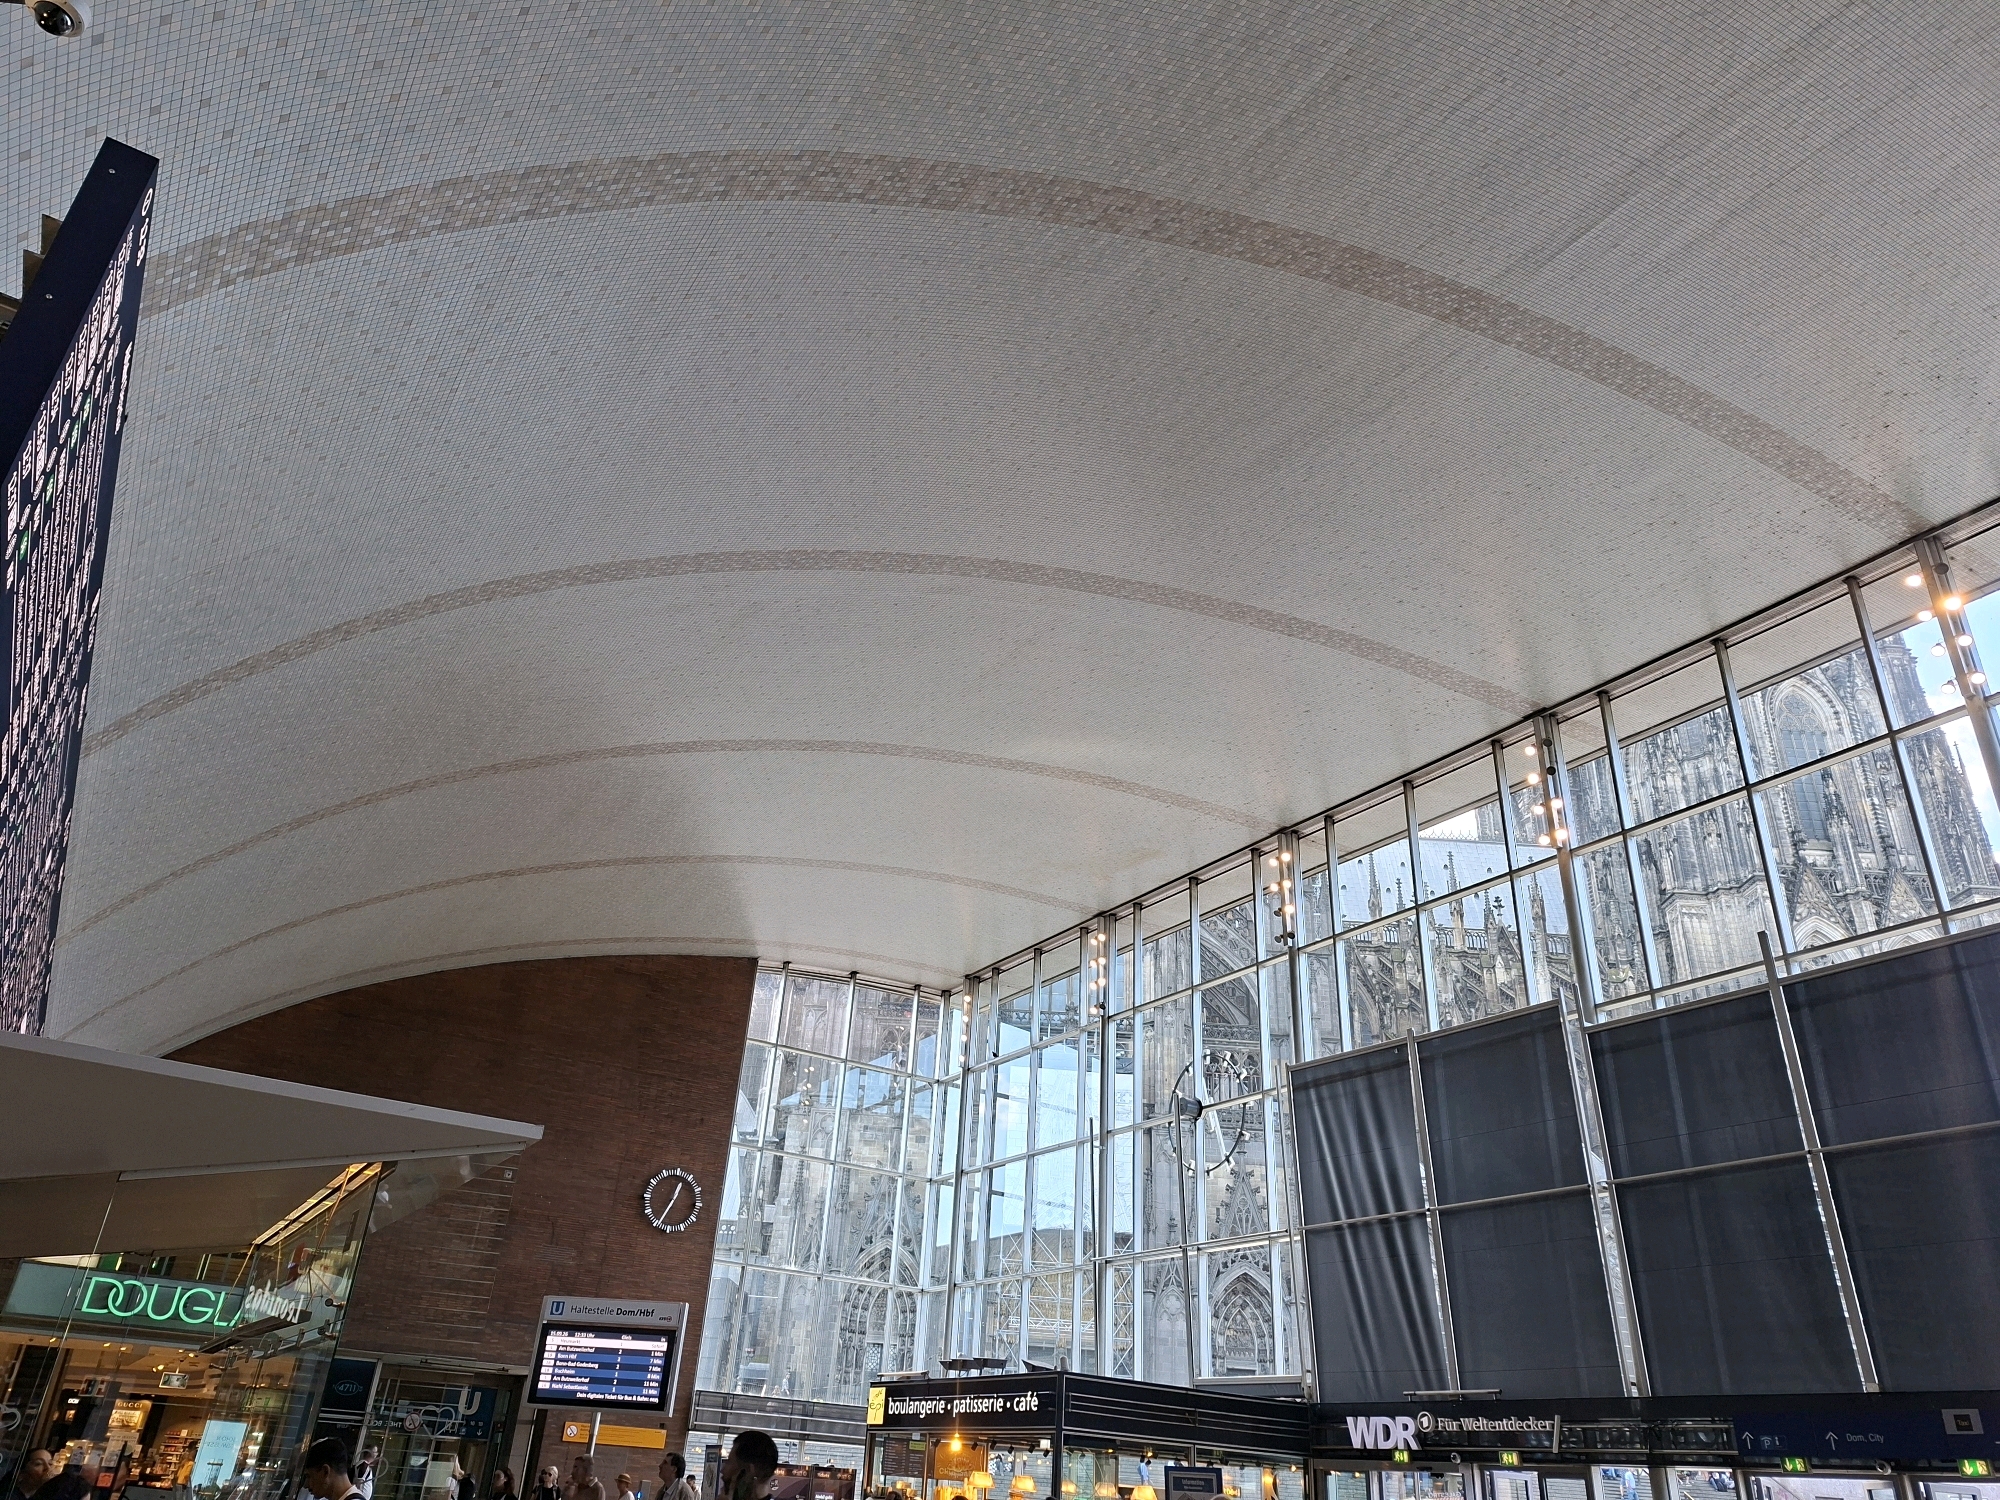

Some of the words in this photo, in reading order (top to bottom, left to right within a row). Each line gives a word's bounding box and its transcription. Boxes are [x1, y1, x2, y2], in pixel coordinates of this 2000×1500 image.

[81, 1276, 243, 1327] DOUGL
[570, 1305, 615, 1316] Haltestelle
[616, 1308, 655, 1317] Dom/Hbf
[117, 1401, 143, 1409] GUCCI
[888, 1396, 945, 1418] boulangerie
[953, 1394, 1004, 1418] patisserie
[1013, 1391, 1039, 1412] café
[1346, 1416, 1422, 1450] WDR
[1437, 1417, 1461, 1431] Für
[1460, 1416, 1554, 1432] Weltentdecker
[1846, 1433, 1868, 1443] Dom,
[1868, 1433, 1885, 1444] City
